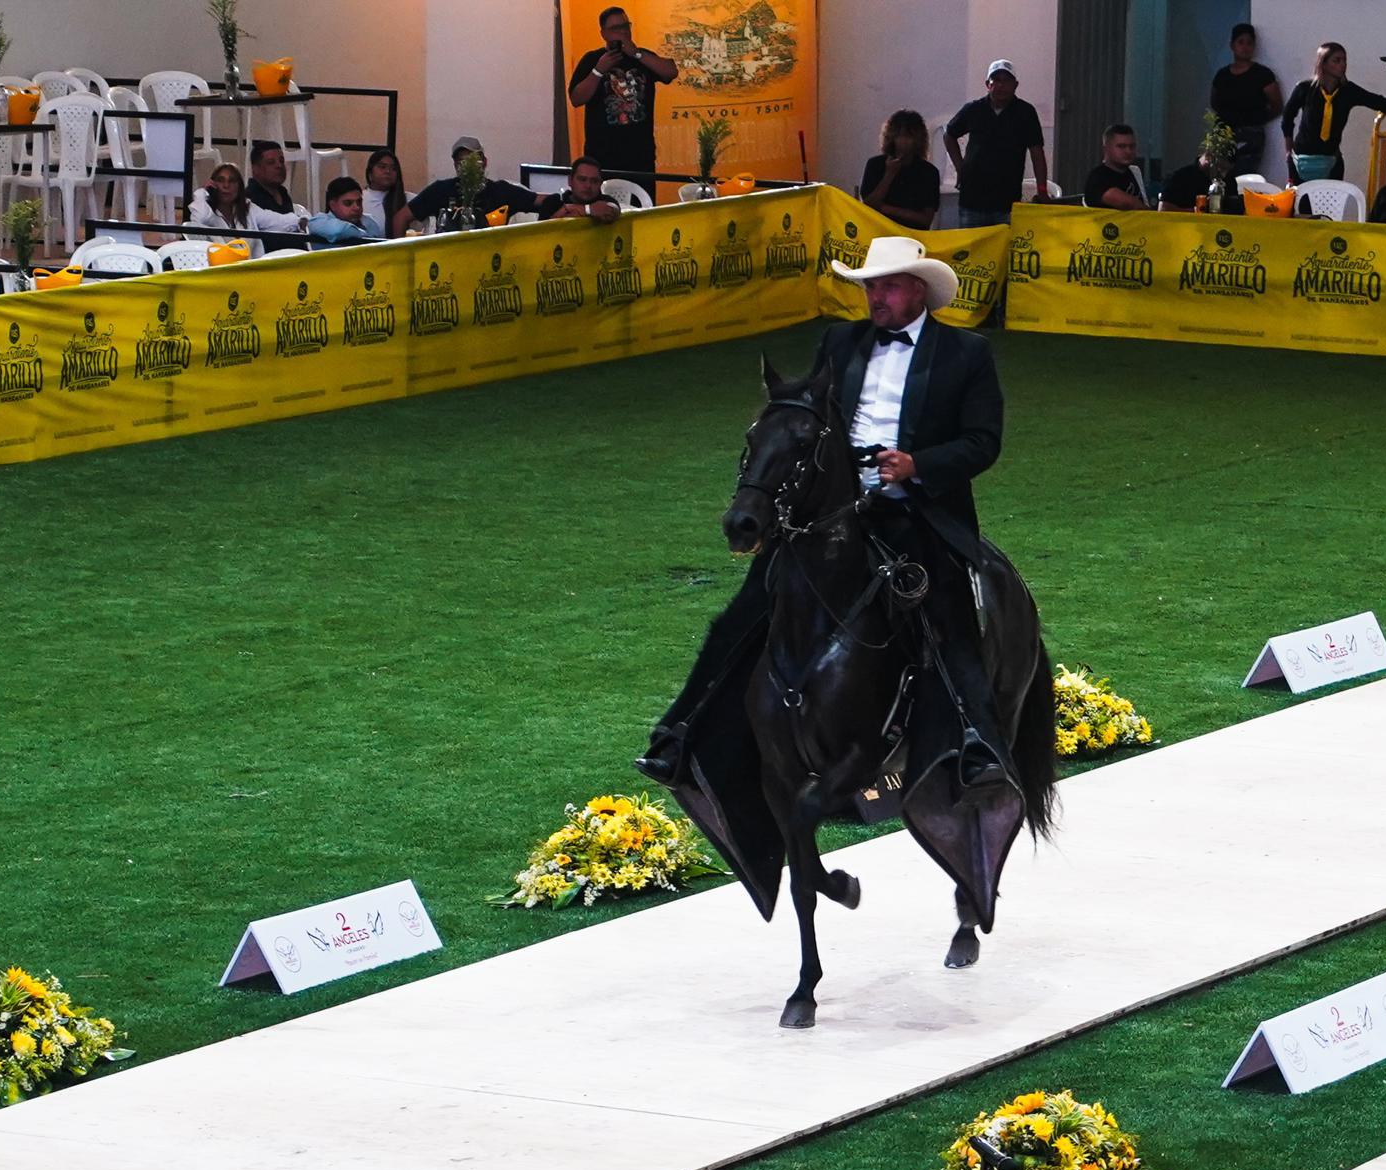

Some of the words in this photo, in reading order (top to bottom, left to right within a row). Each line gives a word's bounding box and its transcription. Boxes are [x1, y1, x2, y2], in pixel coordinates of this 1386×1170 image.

[708, 109, 738, 117] VOL
[765, 242, 807, 278] AMARILLO
[1074, 237, 1147, 262] Aguardiente
[1187, 244, 1261, 269] Aguardiente
[1300, 251, 1376, 275] Aguardiente
[1067, 253, 1153, 288] AMARILLO
[1179, 258, 1266, 294] AMARILLO
[1293, 265, 1381, 302] AMARILLO
[473, 285, 522, 325] AMARILLO
[535, 275, 584, 315] AMARILLO
[343, 303, 395, 346] AMARILLO
[409, 293, 459, 336] AMARILLO
[205, 324, 260, 368] AMARILLO
[275, 314, 328, 356] AMARILLO
[60, 346, 118, 391] AMARILLO
[134, 336, 191, 379] AMARILLO
[1325, 633, 1335, 648] 2
[335, 912, 351, 931] 2
[1331, 1006, 1344, 1027] 2
